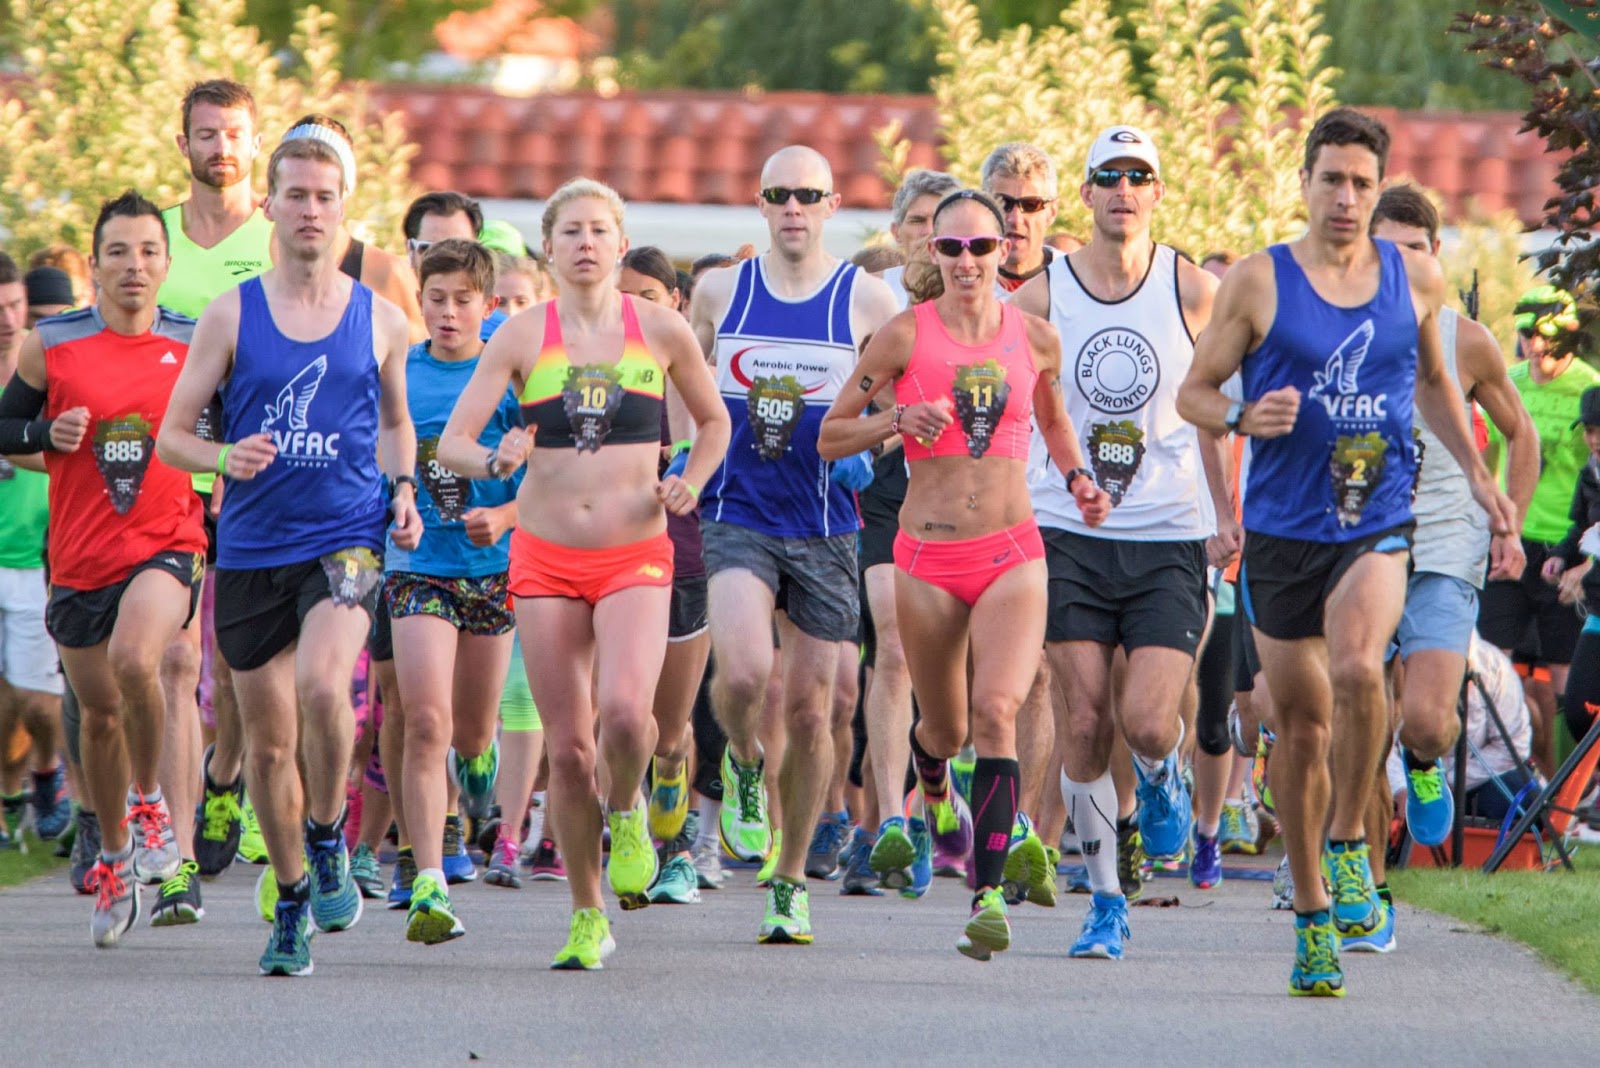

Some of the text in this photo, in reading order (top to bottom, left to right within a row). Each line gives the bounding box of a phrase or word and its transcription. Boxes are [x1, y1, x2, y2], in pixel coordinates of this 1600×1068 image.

[752, 359, 829, 373] Aerobic Power
[1081, 334, 1154, 378] BLACK LUNGS
[580, 385, 607, 410] 10
[970, 384, 993, 408] 11
[1089, 384, 1149, 409] TORONTO
[1323, 393, 1388, 418] VFAC
[756, 396, 794, 422] 505
[103, 440, 143, 462] 885
[274, 429, 341, 457] VFAC
[1098, 441, 1135, 466] 888
[1350, 458, 1367, 481] 2
